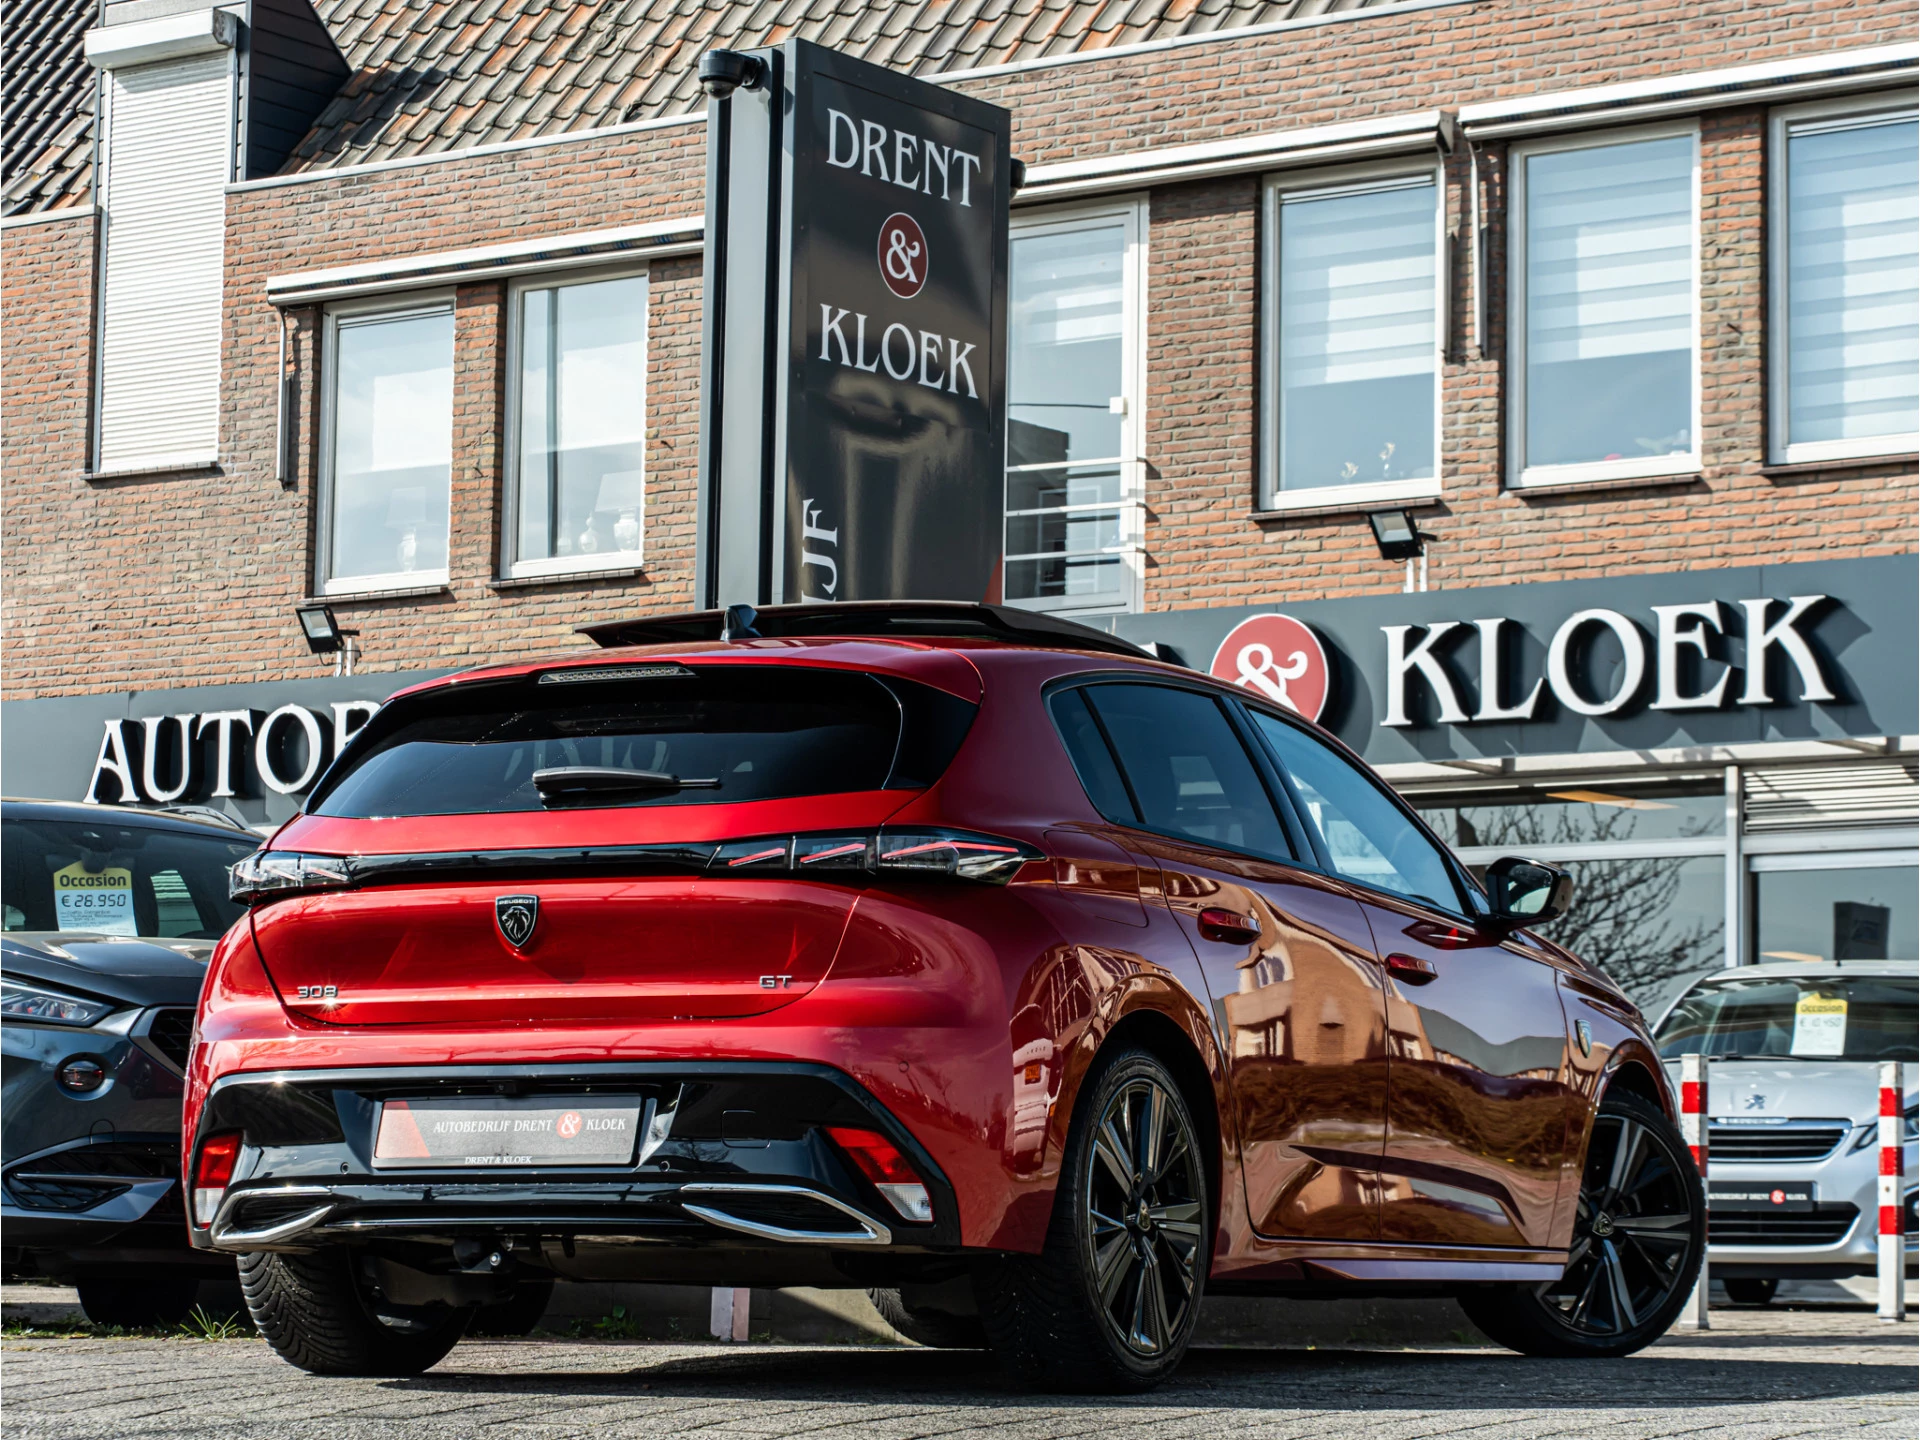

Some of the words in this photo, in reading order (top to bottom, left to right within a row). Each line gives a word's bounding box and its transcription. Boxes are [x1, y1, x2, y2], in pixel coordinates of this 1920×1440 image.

[826, 108, 981, 207] DRENT
[886, 228, 921, 284] &
[818, 303, 979, 400] KLOEK
[1379, 594, 1836, 728] KLOEK
[60, 873, 127, 887] Occasion
[297, 985, 338, 998] 308
[759, 974, 792, 988] GT
[433, 1120, 511, 1133] AUTOBEDRIJF
[513, 1119, 552, 1132] DRENT
[560, 1113, 580, 1135] &
[586, 1118, 626, 1131] KLOEK
[464, 1156, 494, 1165] DRENT
[502, 1156, 533, 1164] KLOEK
